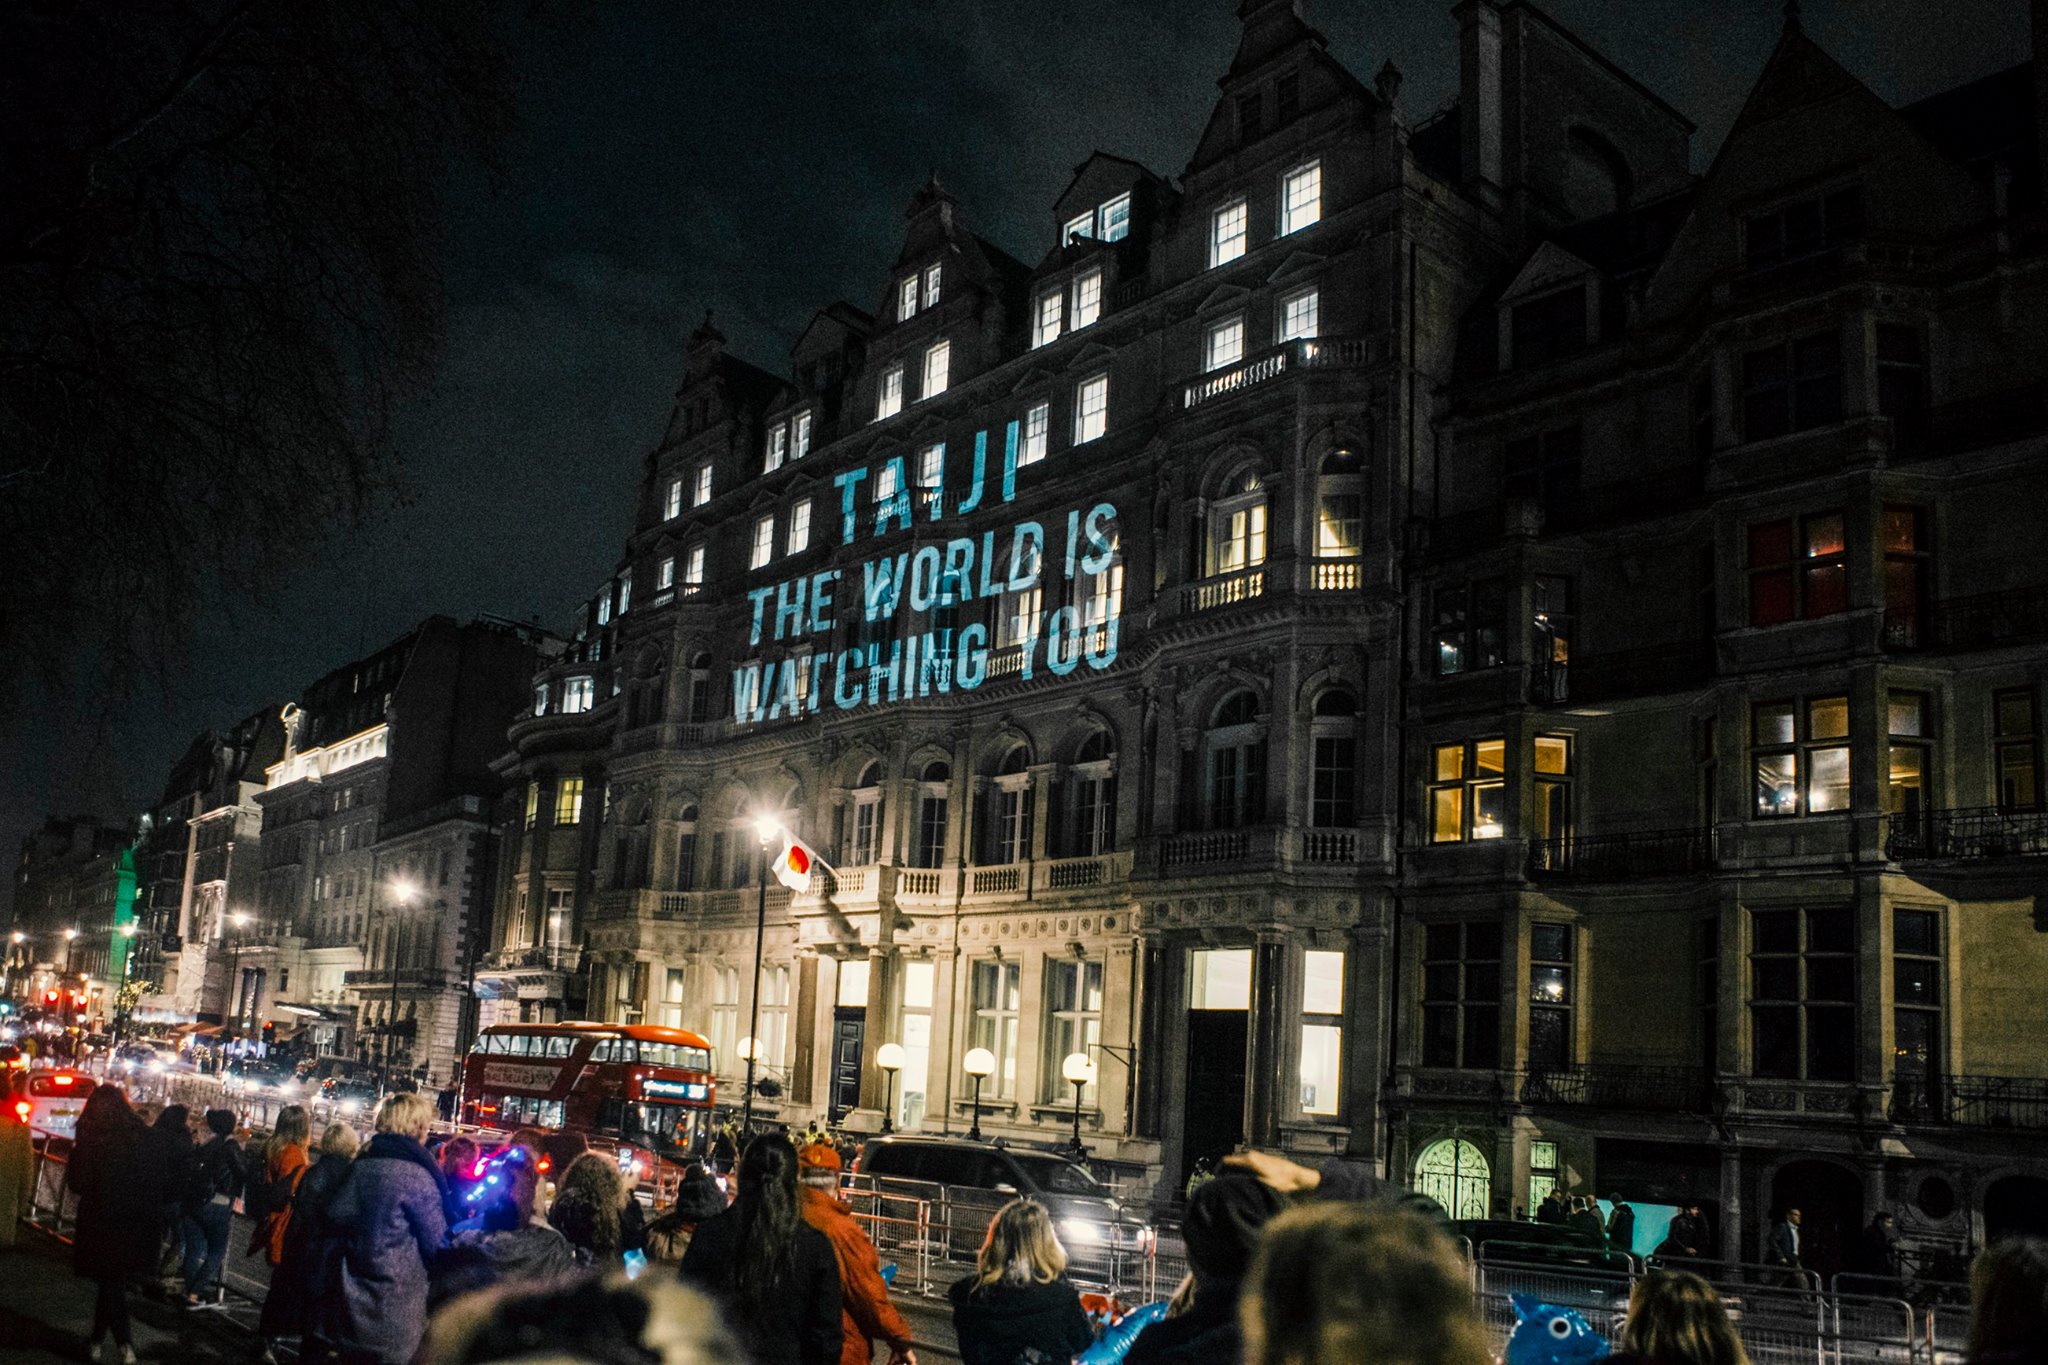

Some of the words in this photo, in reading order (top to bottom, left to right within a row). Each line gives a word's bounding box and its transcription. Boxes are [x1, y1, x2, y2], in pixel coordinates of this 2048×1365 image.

[834, 420, 1020, 545] TAIJI
[748, 570, 842, 646] THE
[863, 521, 1044, 622] WORLD
[1065, 503, 1117, 579] IS
[732, 623, 988, 725] WATCHING
[1011, 606, 1120, 680] YOU
